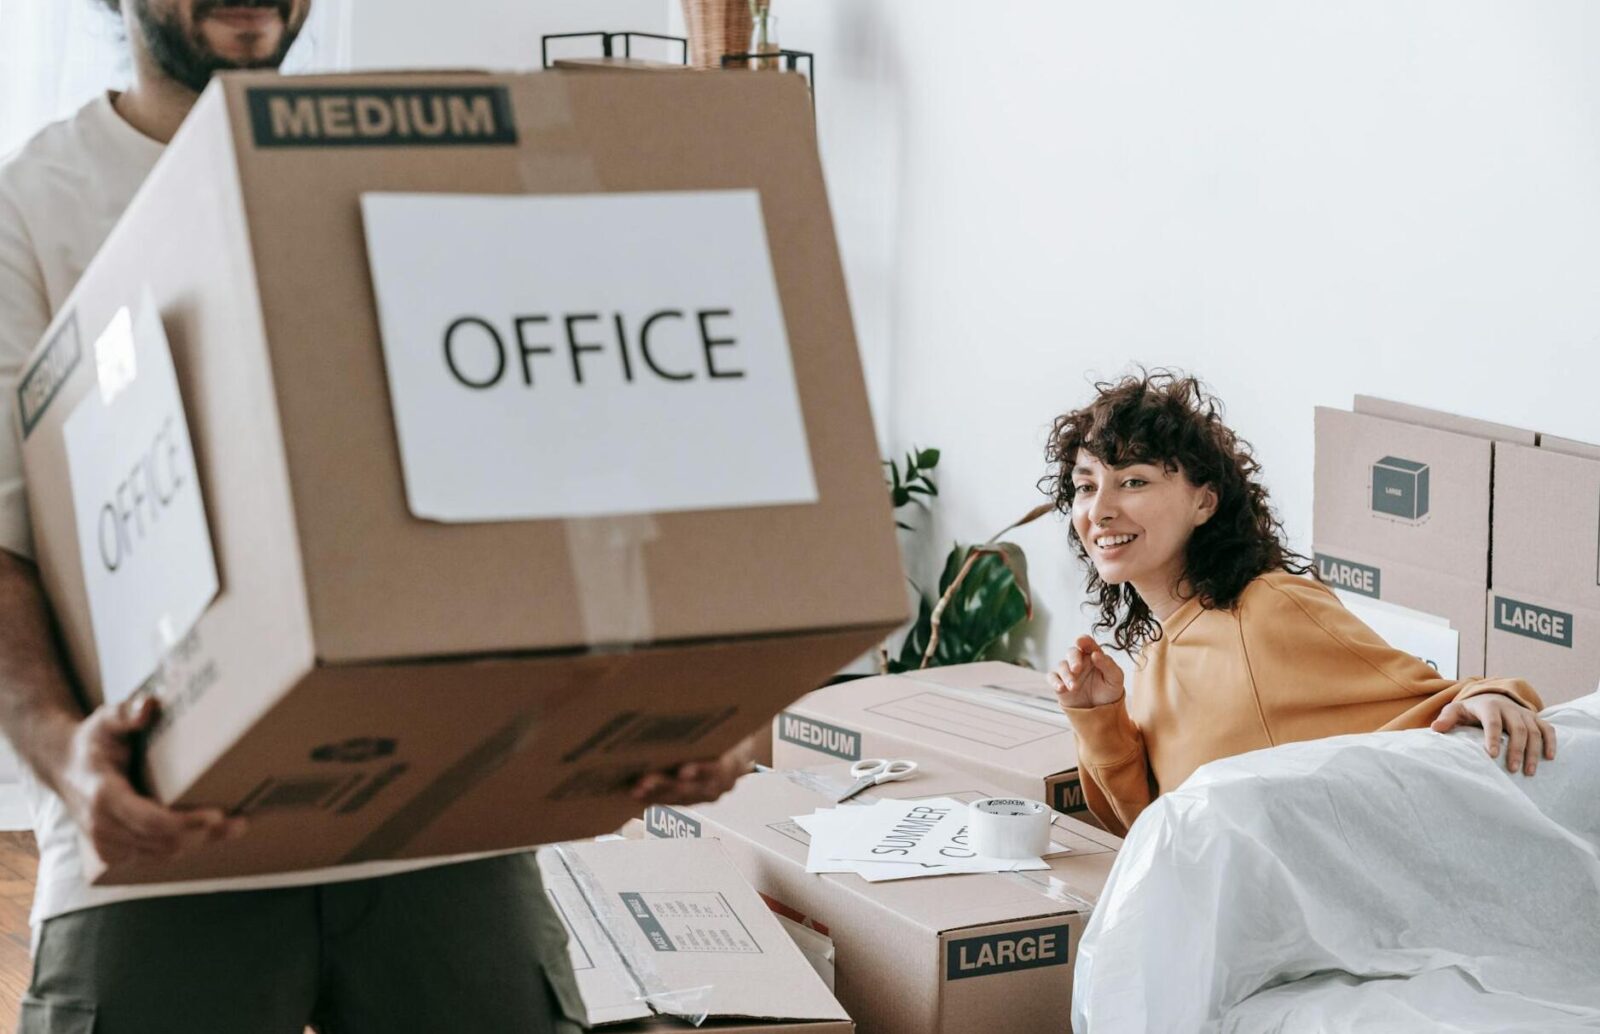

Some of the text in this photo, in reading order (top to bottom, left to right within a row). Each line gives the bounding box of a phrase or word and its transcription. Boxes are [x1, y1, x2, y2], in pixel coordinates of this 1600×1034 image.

[269, 93, 496, 139] MEDIUM
[442, 307, 745, 389] OFFICE
[98, 413, 186, 573] OFFICE
[1320, 559, 1374, 592] LARGE
[1501, 603, 1564, 639] LARGE
[784, 717, 855, 756] MEDIUM
[651, 806, 696, 838] LARGE
[871, 806, 951, 856] SUMMER
[959, 931, 1056, 970] LARGE
